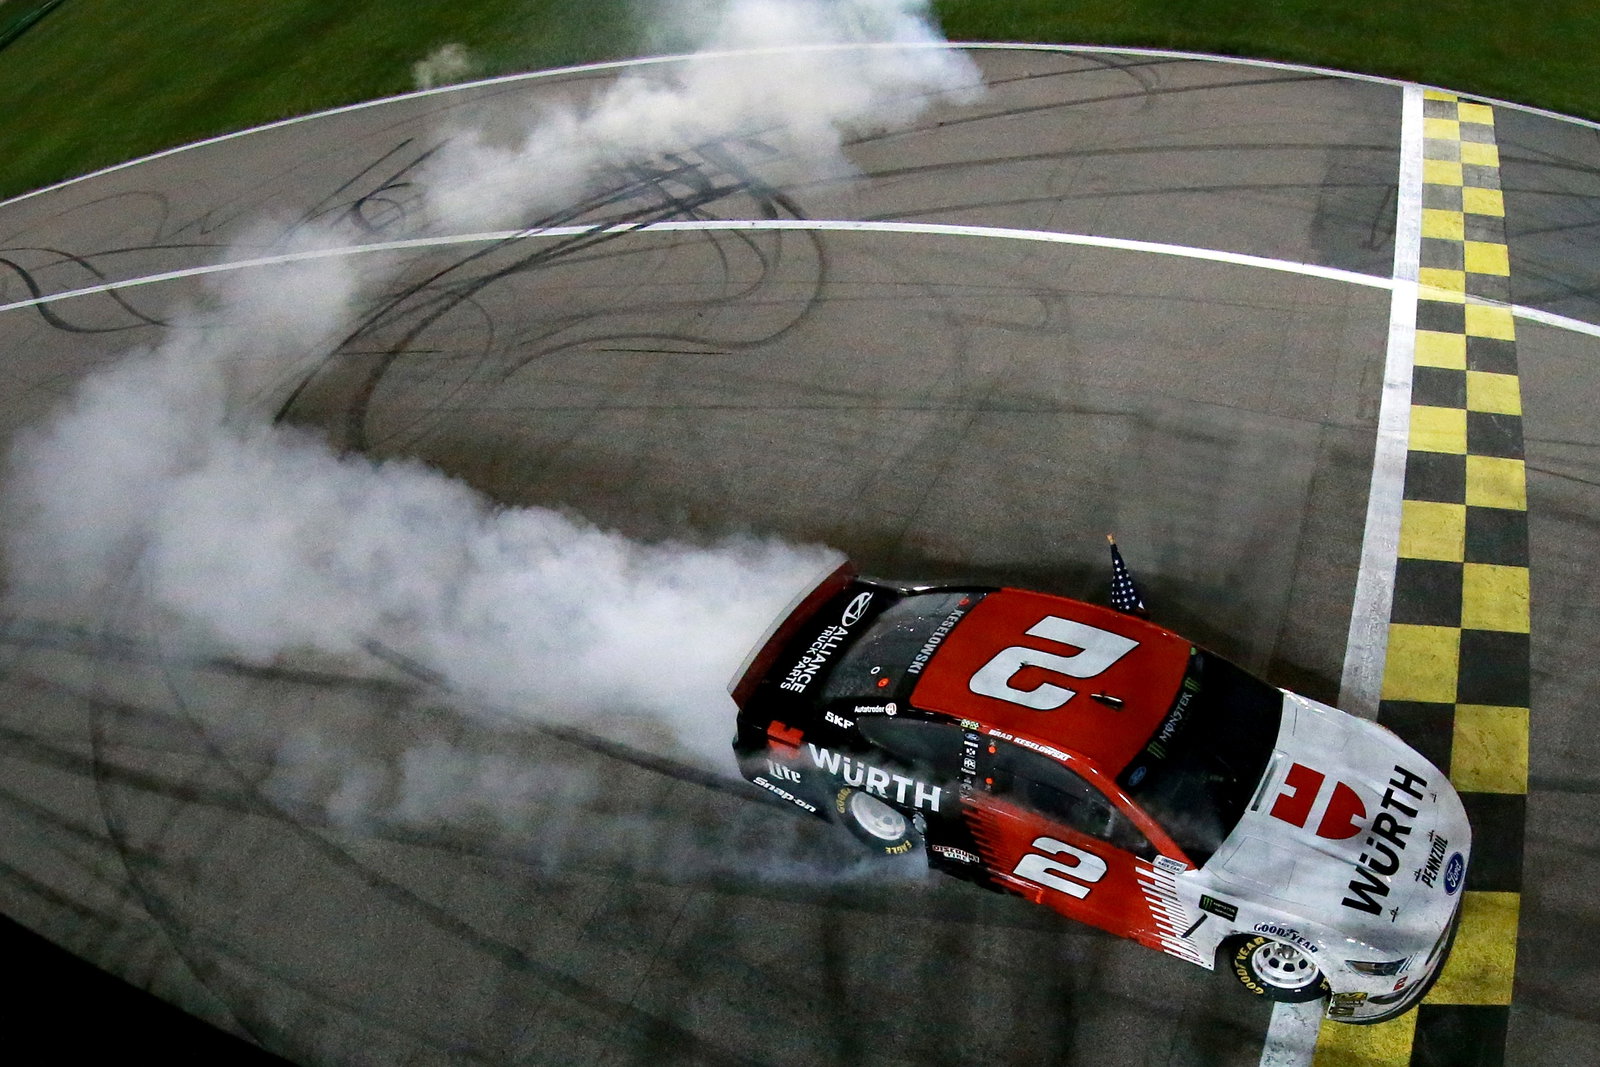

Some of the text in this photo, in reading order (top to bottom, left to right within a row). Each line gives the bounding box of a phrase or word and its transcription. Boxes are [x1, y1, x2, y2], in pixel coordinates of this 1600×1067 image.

[779, 625, 838, 689] TRUCK PARTS
[789, 626, 849, 693] ALLIANCE
[907, 607, 965, 674] KESELOWSKI
[968, 614, 1141, 712] 2
[824, 710, 855, 730] SKF
[854, 704, 885, 714] Autotrader
[988, 728, 1014, 741] BRAD
[752, 776, 817, 813] Snap-on
[765, 758, 801, 784] Lite
[807, 742, 943, 813] WÜRTH
[1012, 836, 1108, 900] 2
[1340, 764, 1428, 917] WÜRTH
[1420, 834, 1448, 889] PENNZOIL
[1445, 856, 1463, 890] Ford
[1234, 936, 1265, 995] GOODYEAR
[1253, 923, 1319, 954] GOODYEAR
